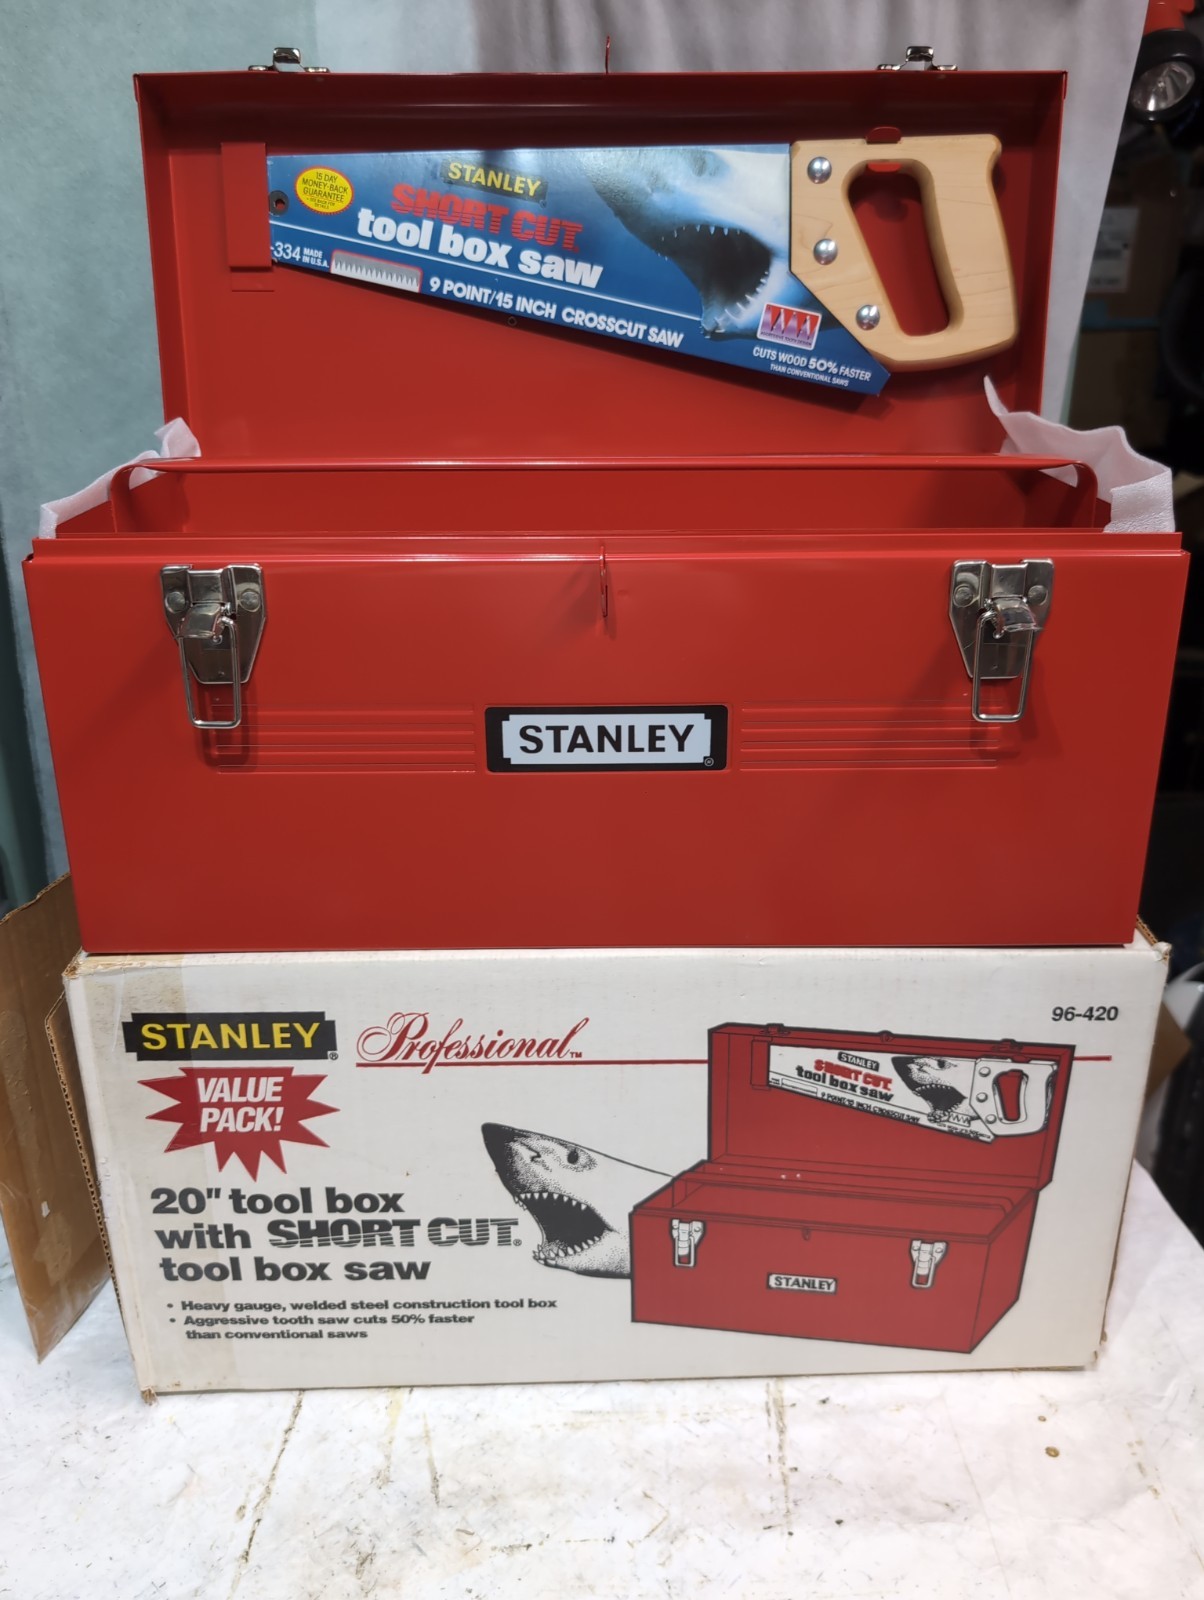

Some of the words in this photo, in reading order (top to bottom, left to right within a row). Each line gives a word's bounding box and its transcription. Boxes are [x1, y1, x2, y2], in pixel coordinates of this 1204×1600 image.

[302, 177, 349, 195] MONEY-BACK
[316, 172, 323, 180] 15
[324, 174, 338, 183] DAY
[448, 162, 541, 198] STANLEY
[303, 186, 345, 203] GUARANTEE
[391, 183, 509, 234] SHORT
[303, 247, 323, 258] MADE
[357, 208, 434, 250] tool
[438, 224, 512, 269] box
[518, 249, 603, 289] saw
[302, 255, 310, 264] IN
[310, 258, 330, 269] U.S.A.
[429, 276, 441, 293] 9
[443, 280, 514, 309] POINT/15
[515, 296, 557, 320] INCH
[561, 306, 648, 340] CROSSCUT
[647, 326, 685, 349] SAW
[753, 346, 777, 361] CUTS
[778, 352, 807, 367] WOOD
[808, 358, 838, 375] 50%
[839, 366, 871, 382] FASTER
[770, 363, 786, 373] THAN
[786, 367, 831, 384] CONVENTIONAL
[831, 377, 849, 387] SAWS
[519, 724, 694, 754] STANLEY
[1051, 1006, 1119, 1022] 96-420
[141, 1022, 320, 1050] STANLEY
[356, 1012, 590, 1074] Professional
[840, 1053, 878, 1070] STANLEY
[197, 1076, 284, 1103] VALUE
[795, 1065, 826, 1084] tool
[829, 1075, 857, 1093] box
[860, 1086, 894, 1102] saw
[200, 1106, 284, 1132] PACK!
[151, 1187, 222, 1214] 20"
[228, 1187, 313, 1214] tool
[325, 1186, 405, 1213] box
[154, 1222, 252, 1249] with
[267, 1218, 421, 1248] SHORT
[159, 1256, 242, 1281] tool
[254, 1256, 332, 1281] box
[344, 1261, 432, 1281] saw
[774, 1276, 834, 1291] STANLEY
[181, 1300, 230, 1313] Heavy
[234, 1302, 287, 1312] gauge,
[290, 1300, 347, 1311] welded
[350, 1300, 389, 1310] steel
[393, 1299, 491, 1310] construction
[494, 1298, 524, 1309] tool
[527, 1298, 557, 1309] box
[184, 1315, 269, 1327] Aggressive
[273, 1315, 313, 1325] tooth
[317, 1316, 349, 1325] saw
[353, 1315, 388, 1324] cuts
[391, 1314, 425, 1324] 50%
[428, 1313, 474, 1324] faster
[186, 1330, 221, 1340] than
[225, 1329, 323, 1340] conventional
[327, 1330, 368, 1339] saws
